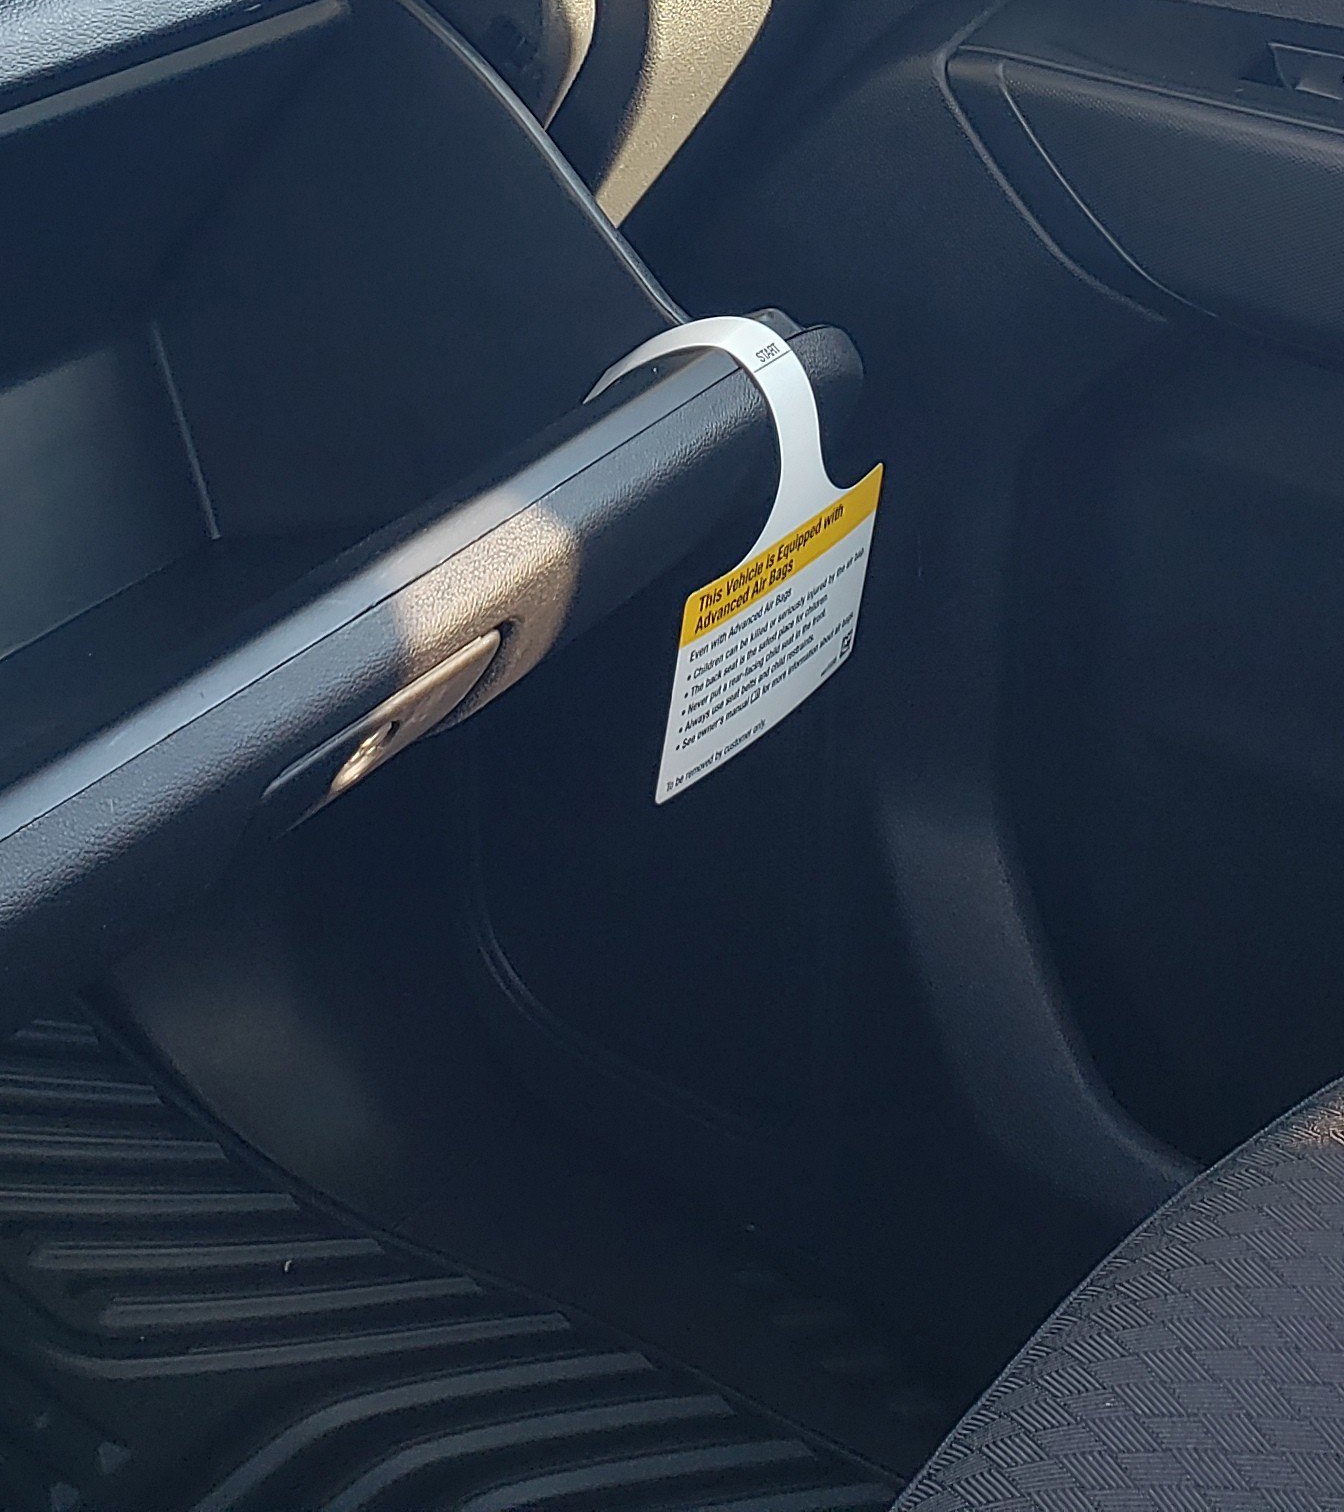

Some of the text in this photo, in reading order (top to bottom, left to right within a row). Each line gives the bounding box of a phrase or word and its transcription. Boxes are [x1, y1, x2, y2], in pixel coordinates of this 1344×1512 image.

[699, 587, 723, 612] This
[726, 561, 764, 596] Vehicle
[777, 516, 823, 562] Equipped
[824, 503, 844, 529] with
[689, 643, 709, 663] Even
[710, 632, 727, 650] with
[728, 605, 764, 639] Advanced
[775, 587, 792, 606] Bags
[694, 559, 794, 635] Advanced Air Bags
[687, 695, 709, 715] Never
[709, 684, 722, 704] put
[722, 682, 728, 692] a
[728, 656, 765, 688] rear-facing
[765, 643, 781, 663] child
[691, 682, 704, 697] The
[705, 669, 722, 688] back
[723, 658, 739, 676] seat
[739, 654, 746, 665] is
[746, 646, 757, 661] the
[693, 653, 724, 679] Children
[725, 644, 739, 659] can
[739, 637, 749, 650] be
[750, 621, 769, 643] killed
[681, 734, 696, 750] See
[725, 695, 750, 721] manual
[684, 709, 711, 733] Always
[711, 700, 725, 715] use
[725, 687, 740, 706] seat
[675, 774, 685, 787] be
